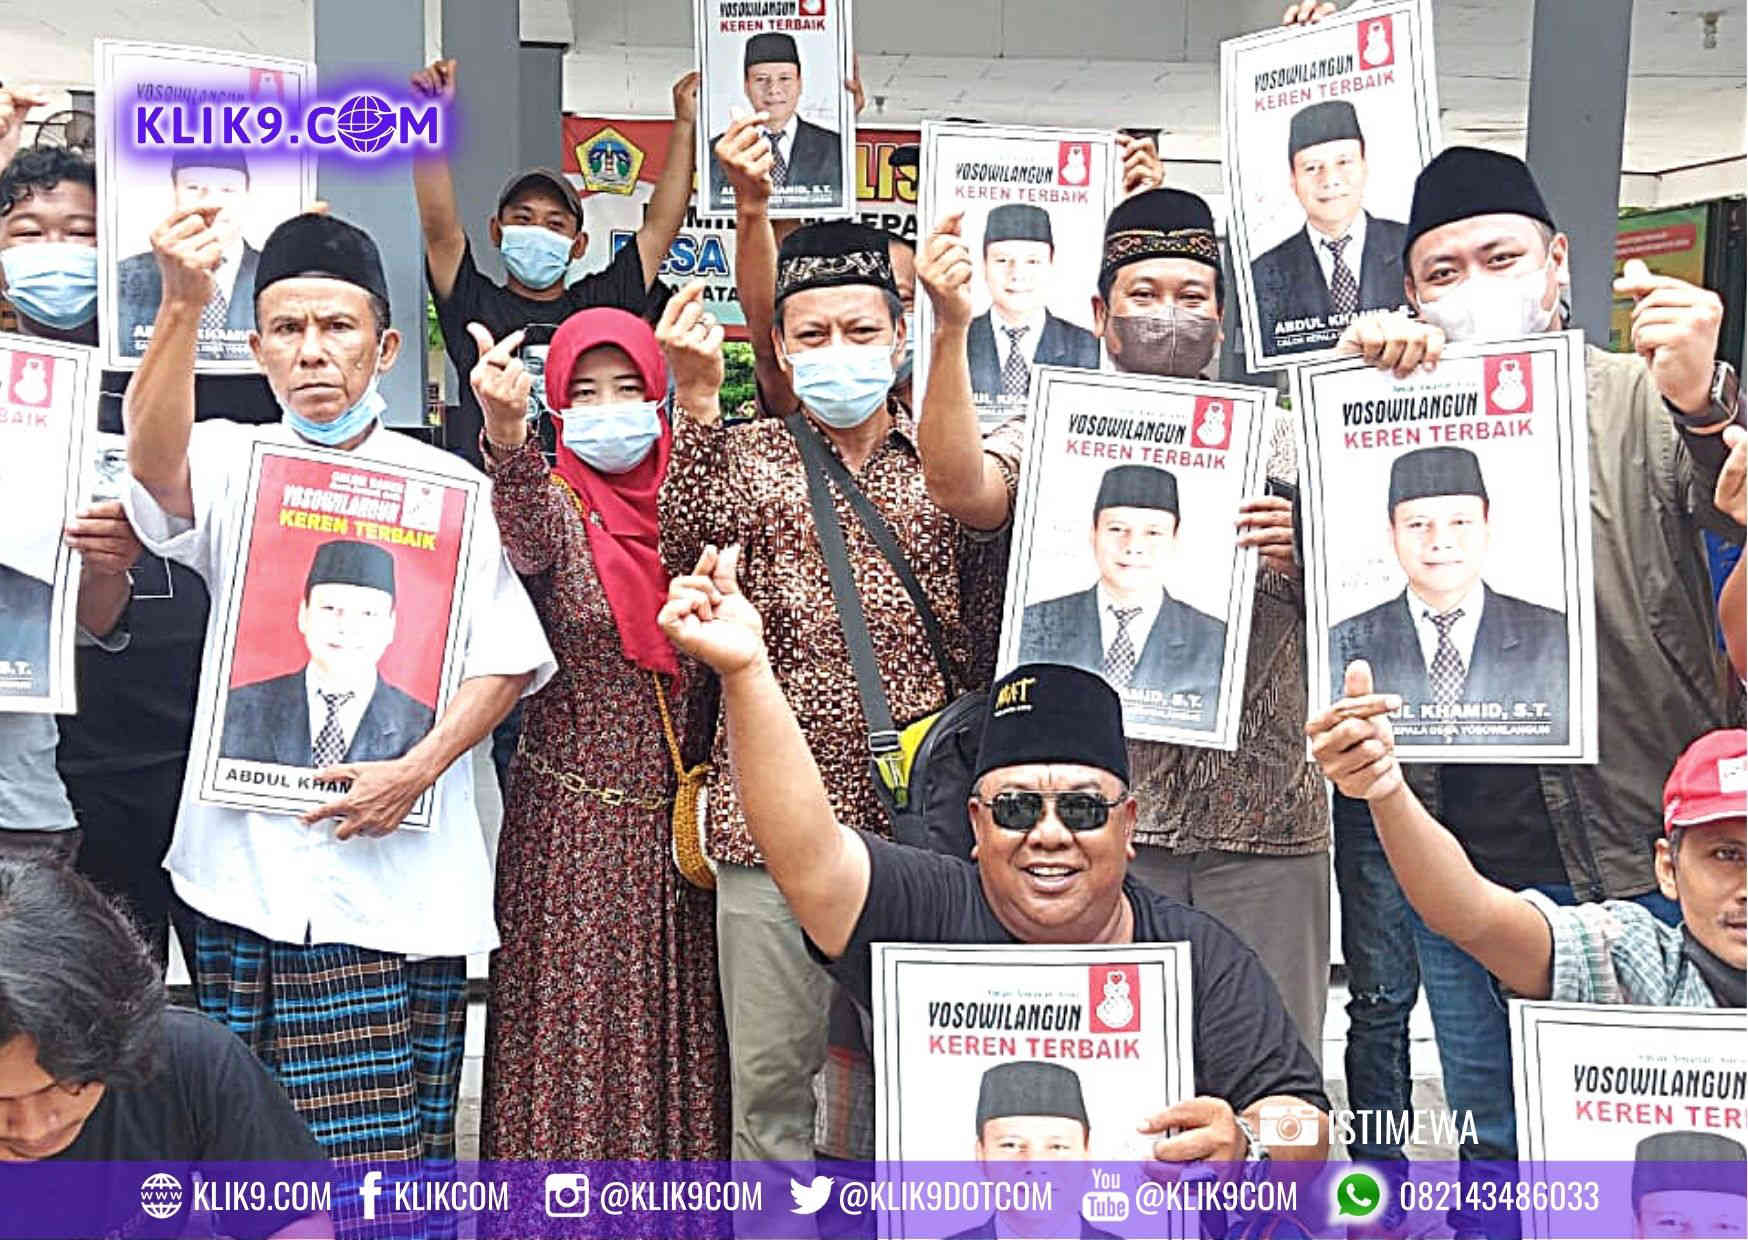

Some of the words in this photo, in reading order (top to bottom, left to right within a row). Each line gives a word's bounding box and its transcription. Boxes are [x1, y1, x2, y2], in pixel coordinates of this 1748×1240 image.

[720, 20, 763, 32] KEREN
[768, 18, 826, 31] TERBAIK
[1254, 54, 1354, 93] YOSOWILANGUN
[1254, 87, 1312, 112] KEREN
[1317, 69, 1395, 98] TERBAIK
[955, 162, 1054, 184] YOSOWILANGUN
[955, 185, 1011, 201] KEREN
[1018, 187, 1089, 203] TERBAIK
[1342, 391, 1478, 427] YOSOWILANGUN
[1068, 413, 1187, 445] YOSOWILANGUN
[1343, 427, 1421, 449] KEREN
[1428, 418, 1534, 442] TERBAIK
[1065, 439, 1133, 460] KEREN
[1140, 446, 1227, 470] TERBAIK
[279, 508, 350, 535] KEREN
[353, 519, 439, 551] TERBAIK
[225, 768, 291, 788] ABDUL
[928, 1001, 1082, 1032] YOSOWILANGUN
[929, 1034, 1016, 1056] KEREN
[1025, 1037, 1140, 1060] TERBAIK
[1573, 1063, 1748, 1101] YOSOWILANGUN
[1575, 1099, 1674, 1126] KEREN
